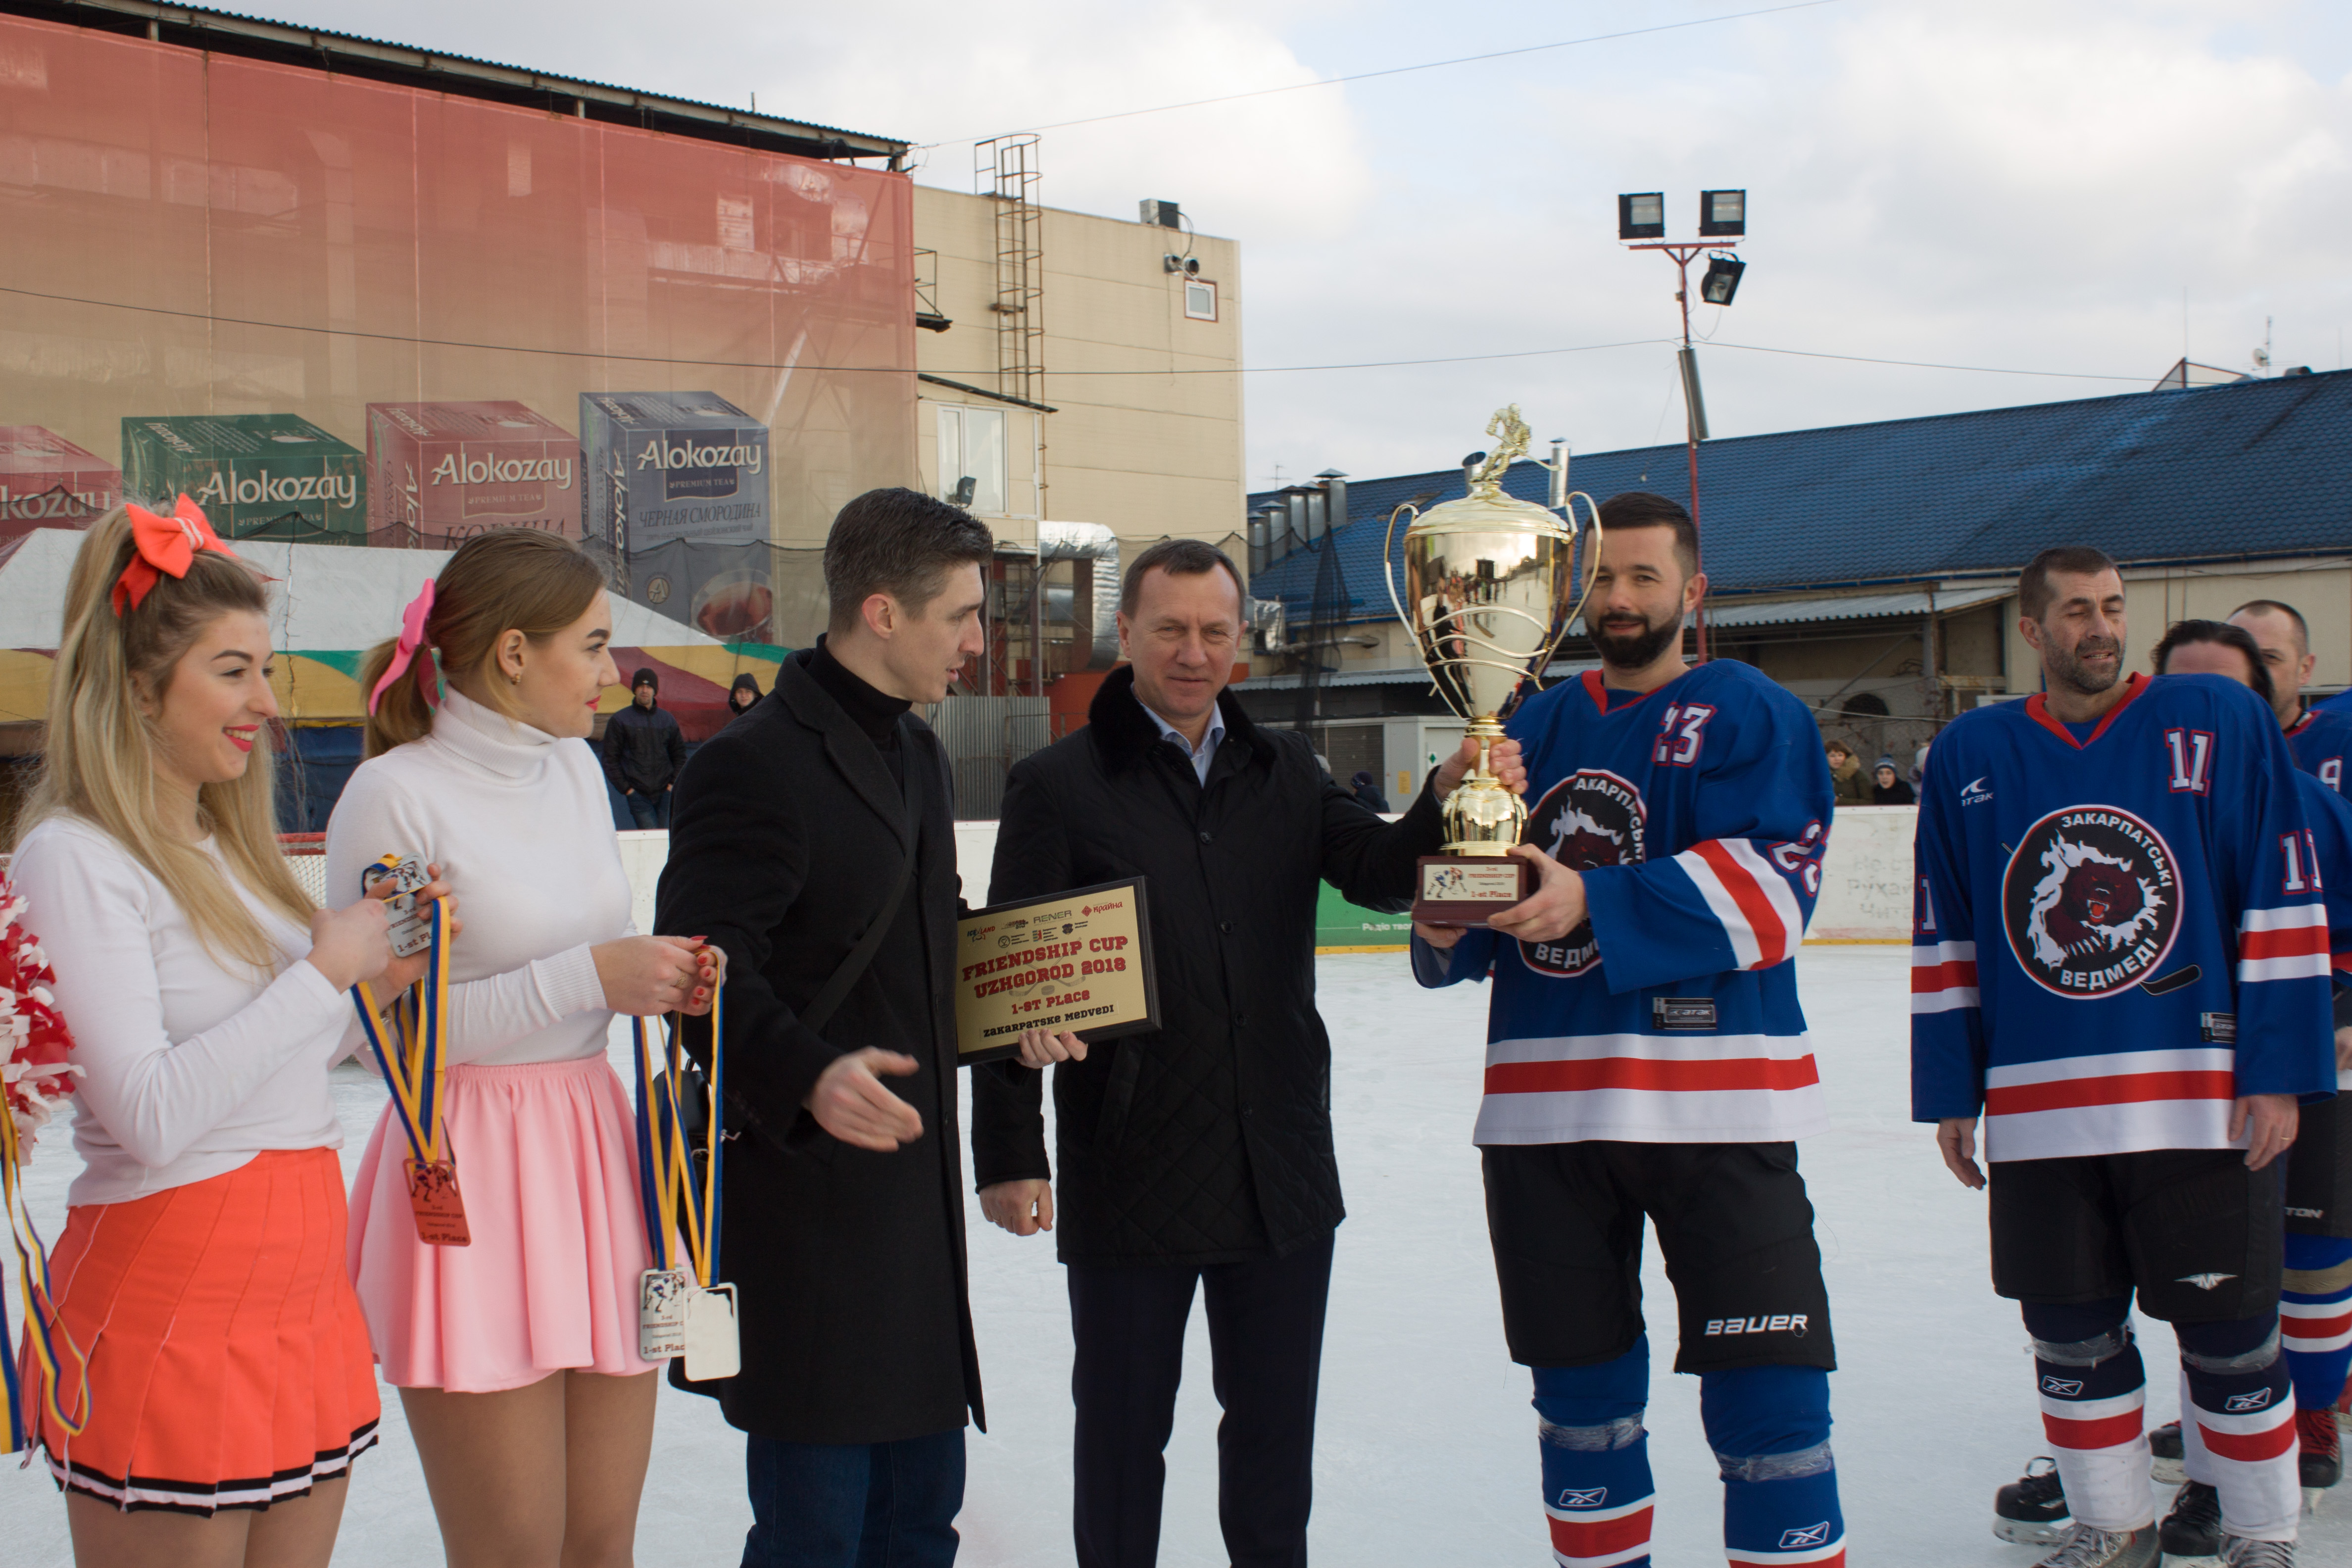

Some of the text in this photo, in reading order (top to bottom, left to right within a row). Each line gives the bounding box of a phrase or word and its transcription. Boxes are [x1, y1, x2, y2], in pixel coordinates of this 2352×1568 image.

[432, 452, 572, 490] Alokozay
[637, 439, 763, 475] Alokozay
[197, 469, 356, 509] Alokozay
[675, 479, 712, 489] PREMIUM
[639, 502, 761, 528] ЧЕРНАЯ СМОРОДИНА
[1651, 701, 1718, 768] 23
[2164, 727, 2214, 797] 11
[2061, 813, 2173, 887] ЗАКАРПАТСЬКІ
[1033, 910, 1072, 924] RENER
[397, 938, 419, 953] 1-st
[962, 936, 1128, 981] FRIENDSHIP CUP
[2060, 937, 2159, 990] ВЕДМЕДІ
[974, 957, 1127, 998] UZHGOROD 2018
[643, 1345, 662, 1354] 1-st
